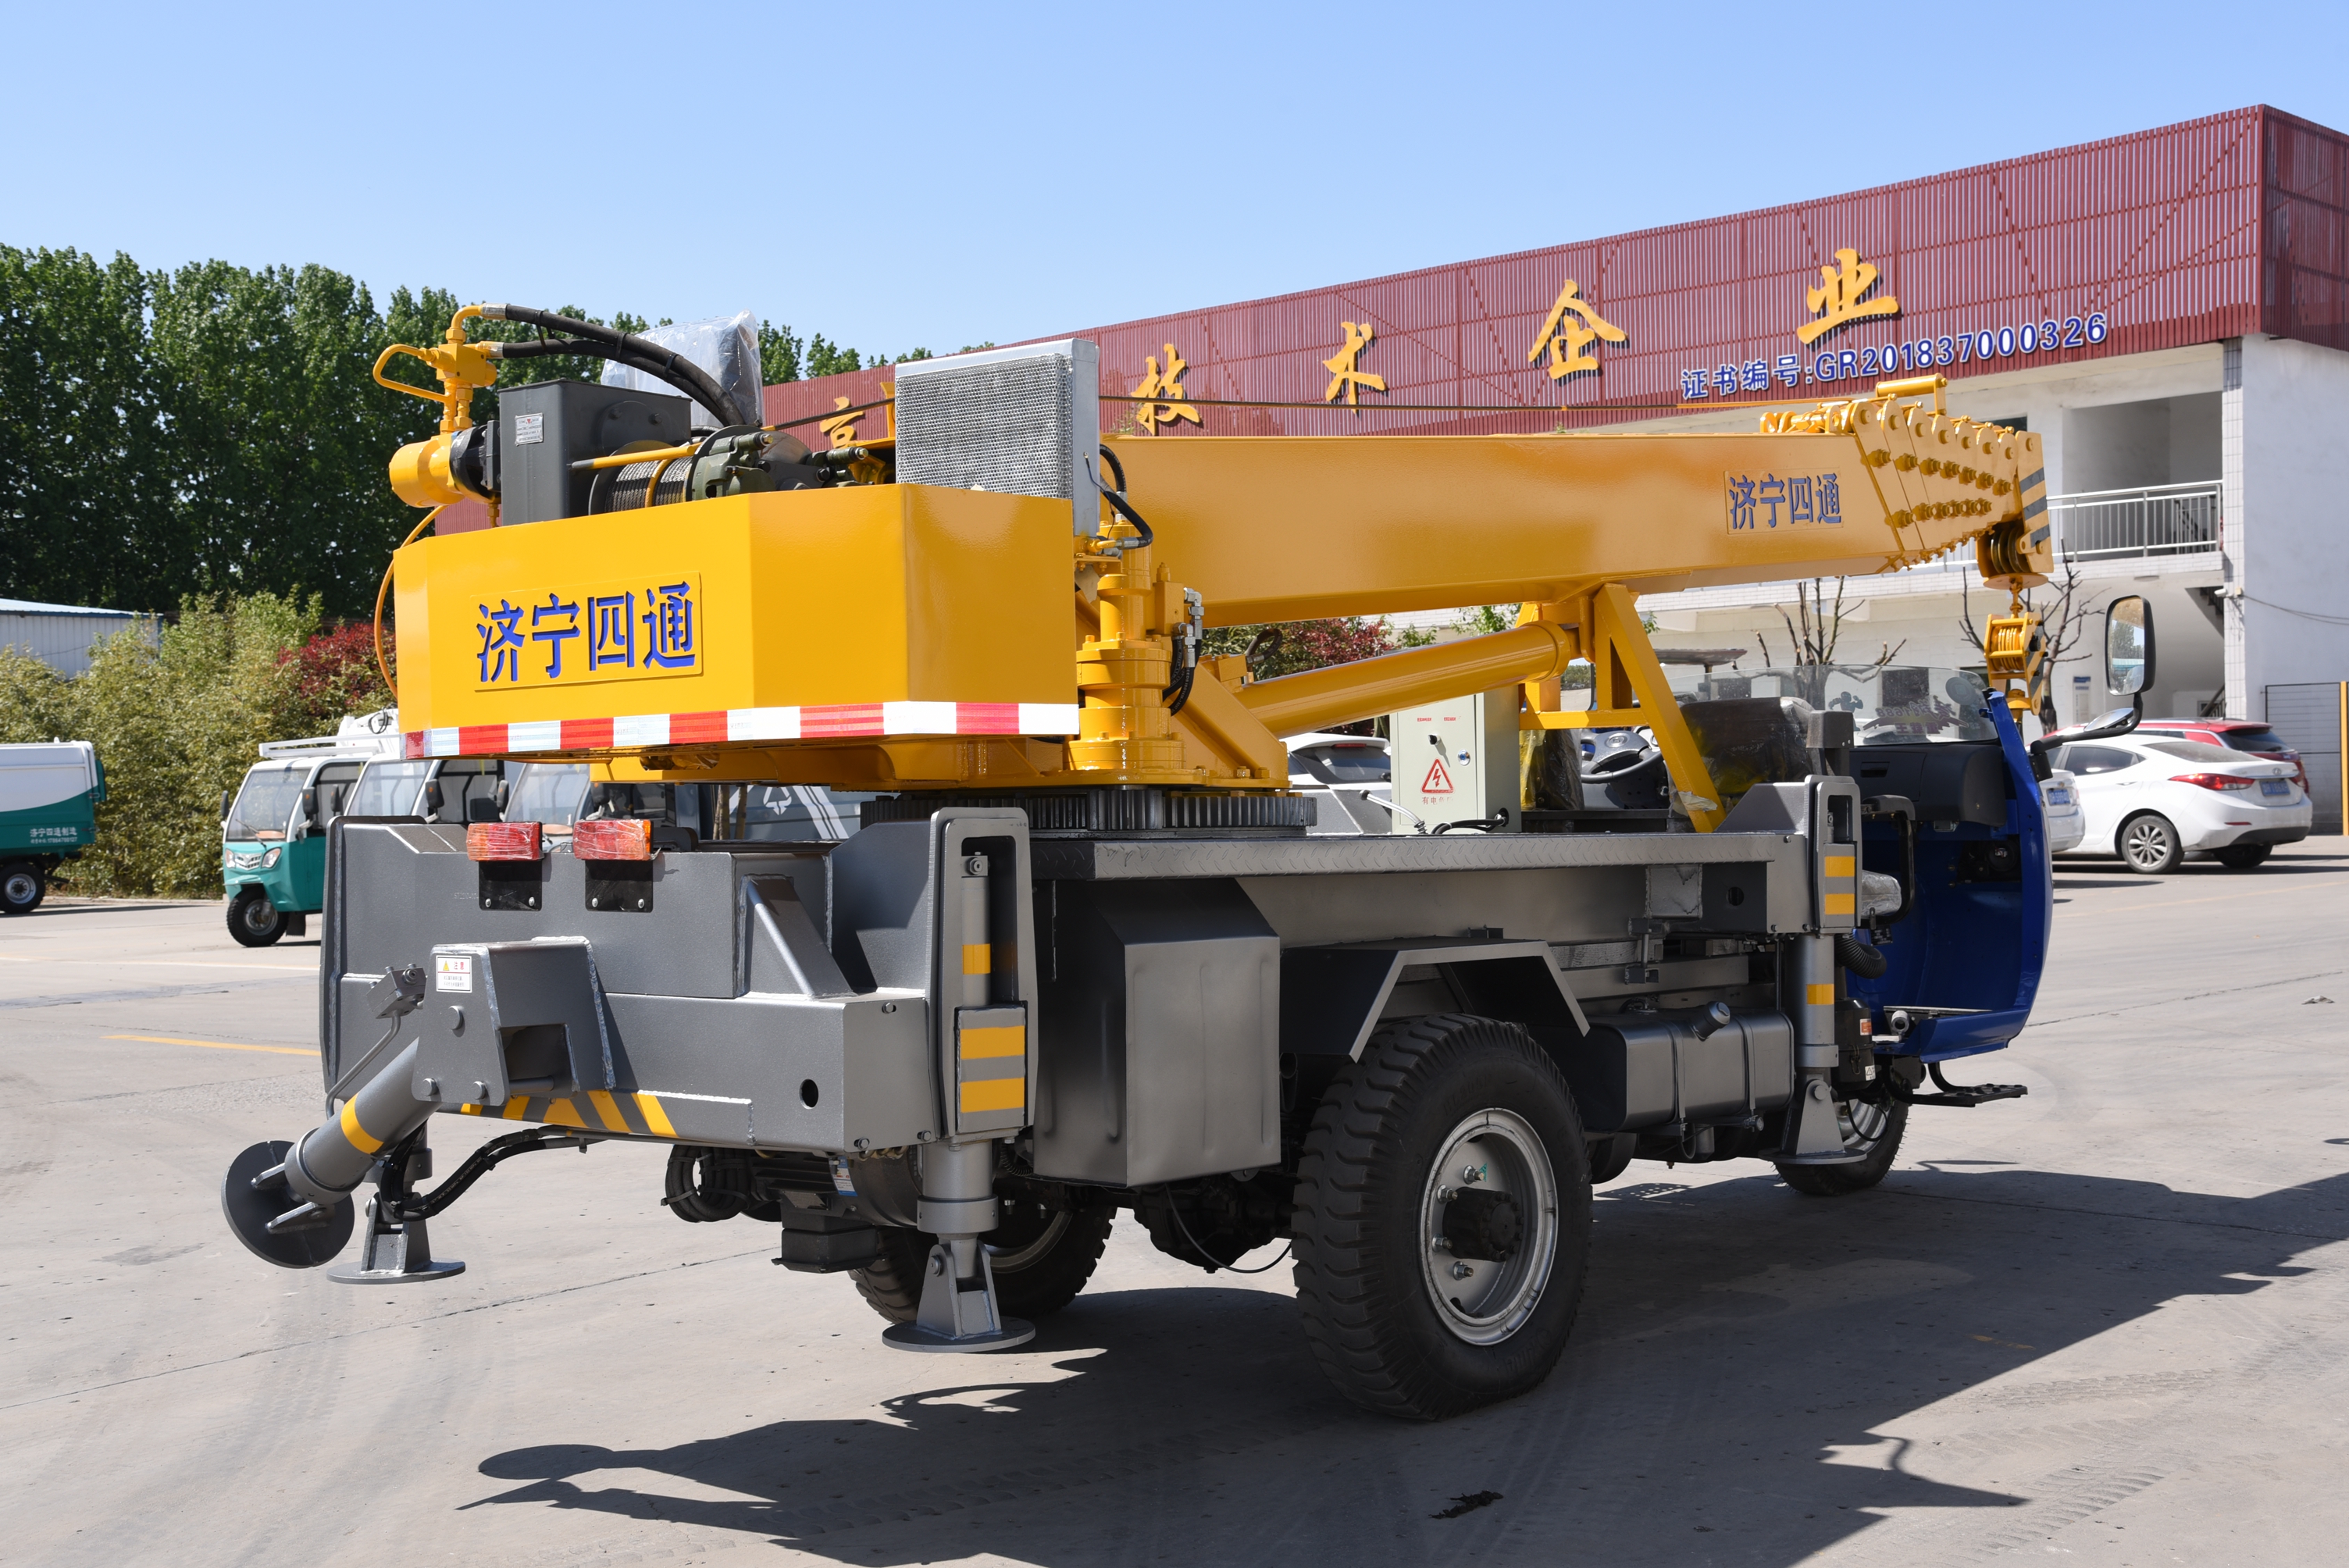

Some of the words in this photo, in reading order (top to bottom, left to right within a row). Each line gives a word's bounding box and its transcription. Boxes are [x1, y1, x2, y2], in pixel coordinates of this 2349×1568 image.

[1728, 472, 1841, 529] 济宁四通
[476, 580, 697, 683] 济宁四通
